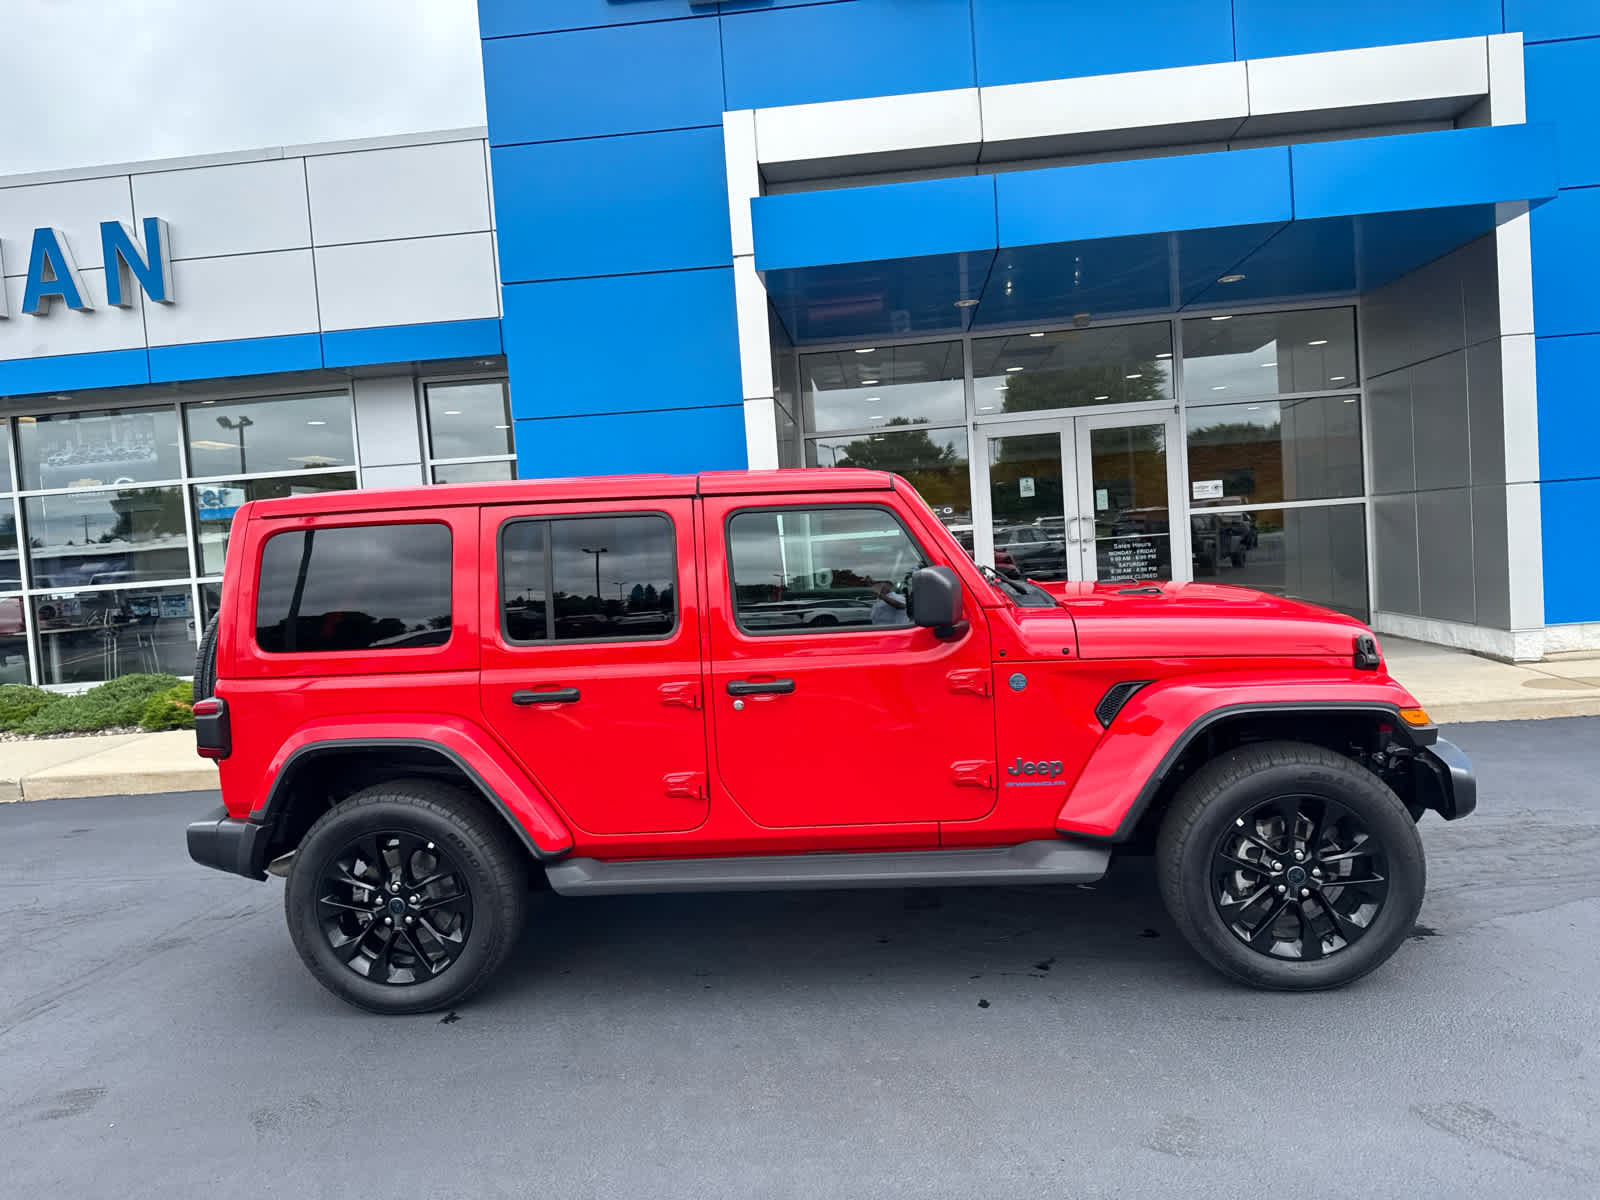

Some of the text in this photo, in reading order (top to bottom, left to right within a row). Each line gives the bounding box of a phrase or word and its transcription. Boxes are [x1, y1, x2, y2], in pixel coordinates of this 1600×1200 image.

[0, 217, 174, 316] AN
[199, 489, 229, 507] er
[1007, 757, 1063, 778] Jeep
